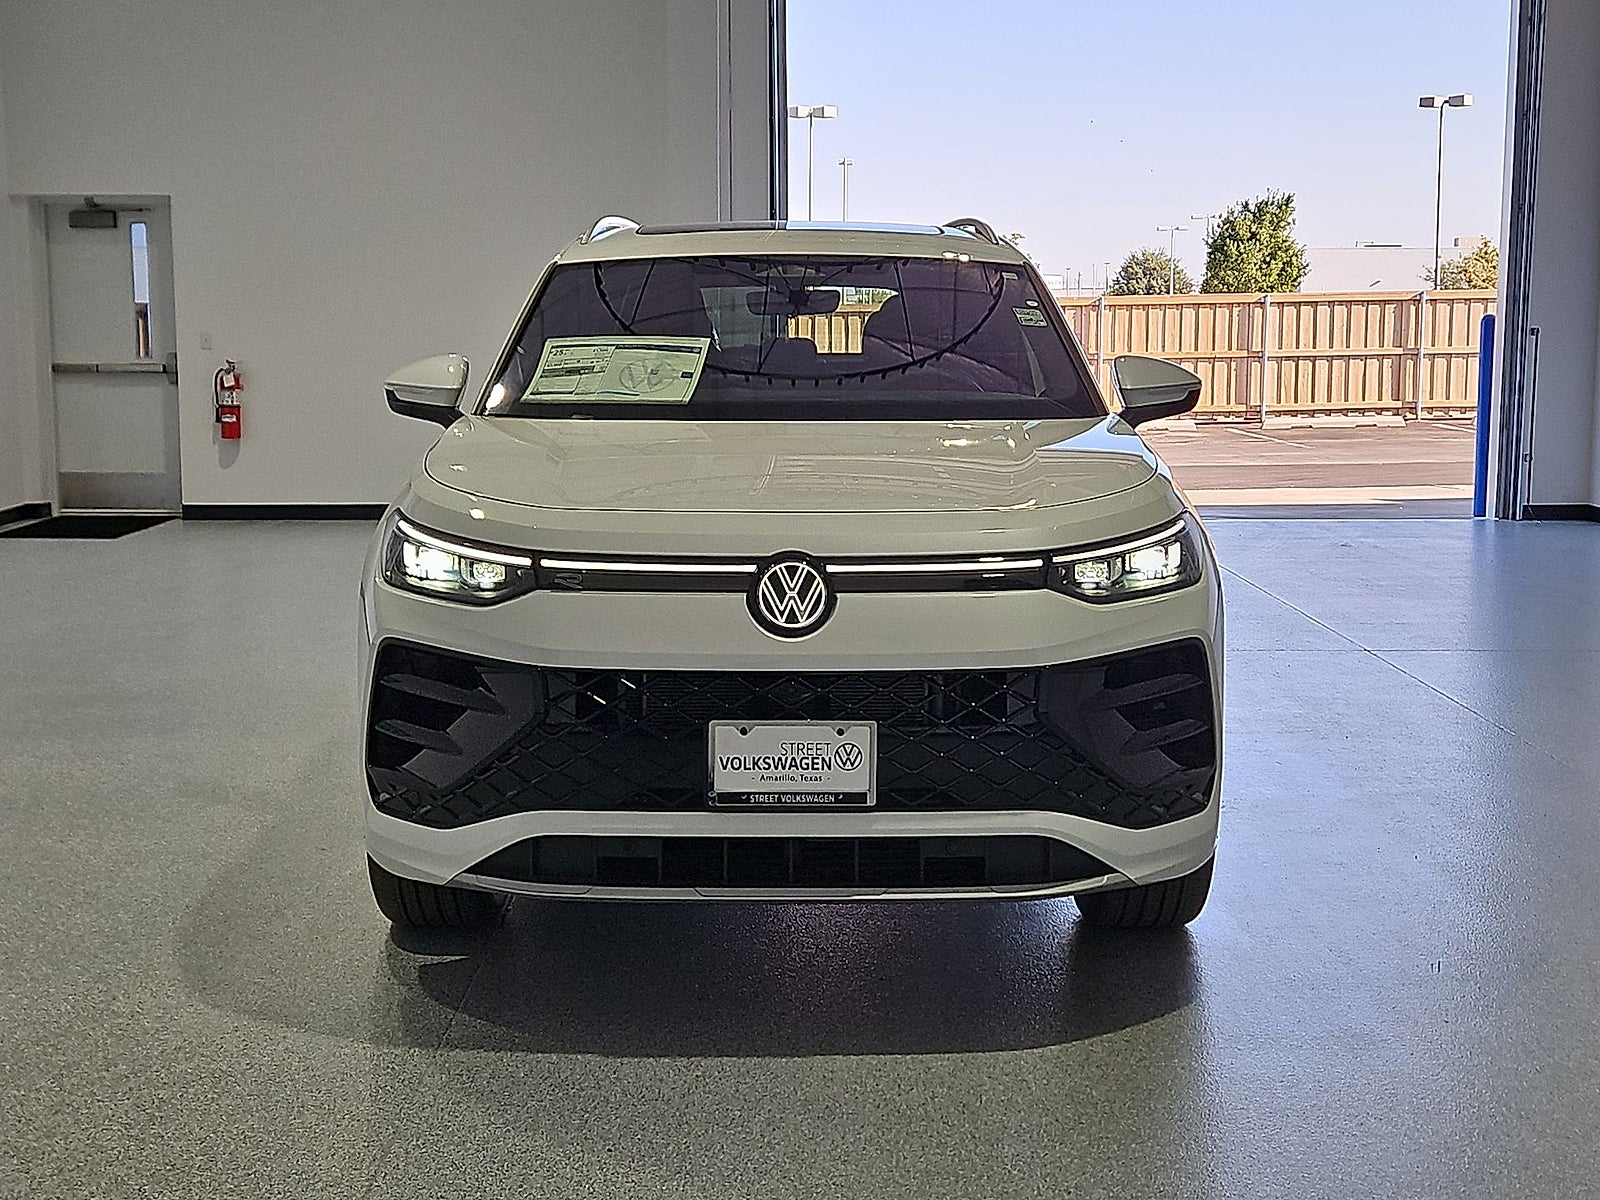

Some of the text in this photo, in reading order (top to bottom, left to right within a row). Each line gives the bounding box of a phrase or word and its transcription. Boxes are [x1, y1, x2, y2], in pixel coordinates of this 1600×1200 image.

[759, 562, 825, 628] VW
[780, 742, 832, 756] STREET
[719, 756, 832, 771] VOLKSWAGEN
[834, 743, 863, 771] VW
[759, 774, 823, 782] Amarillo, Texas
[750, 794, 835, 803] STREET VOLKSWAGEN
